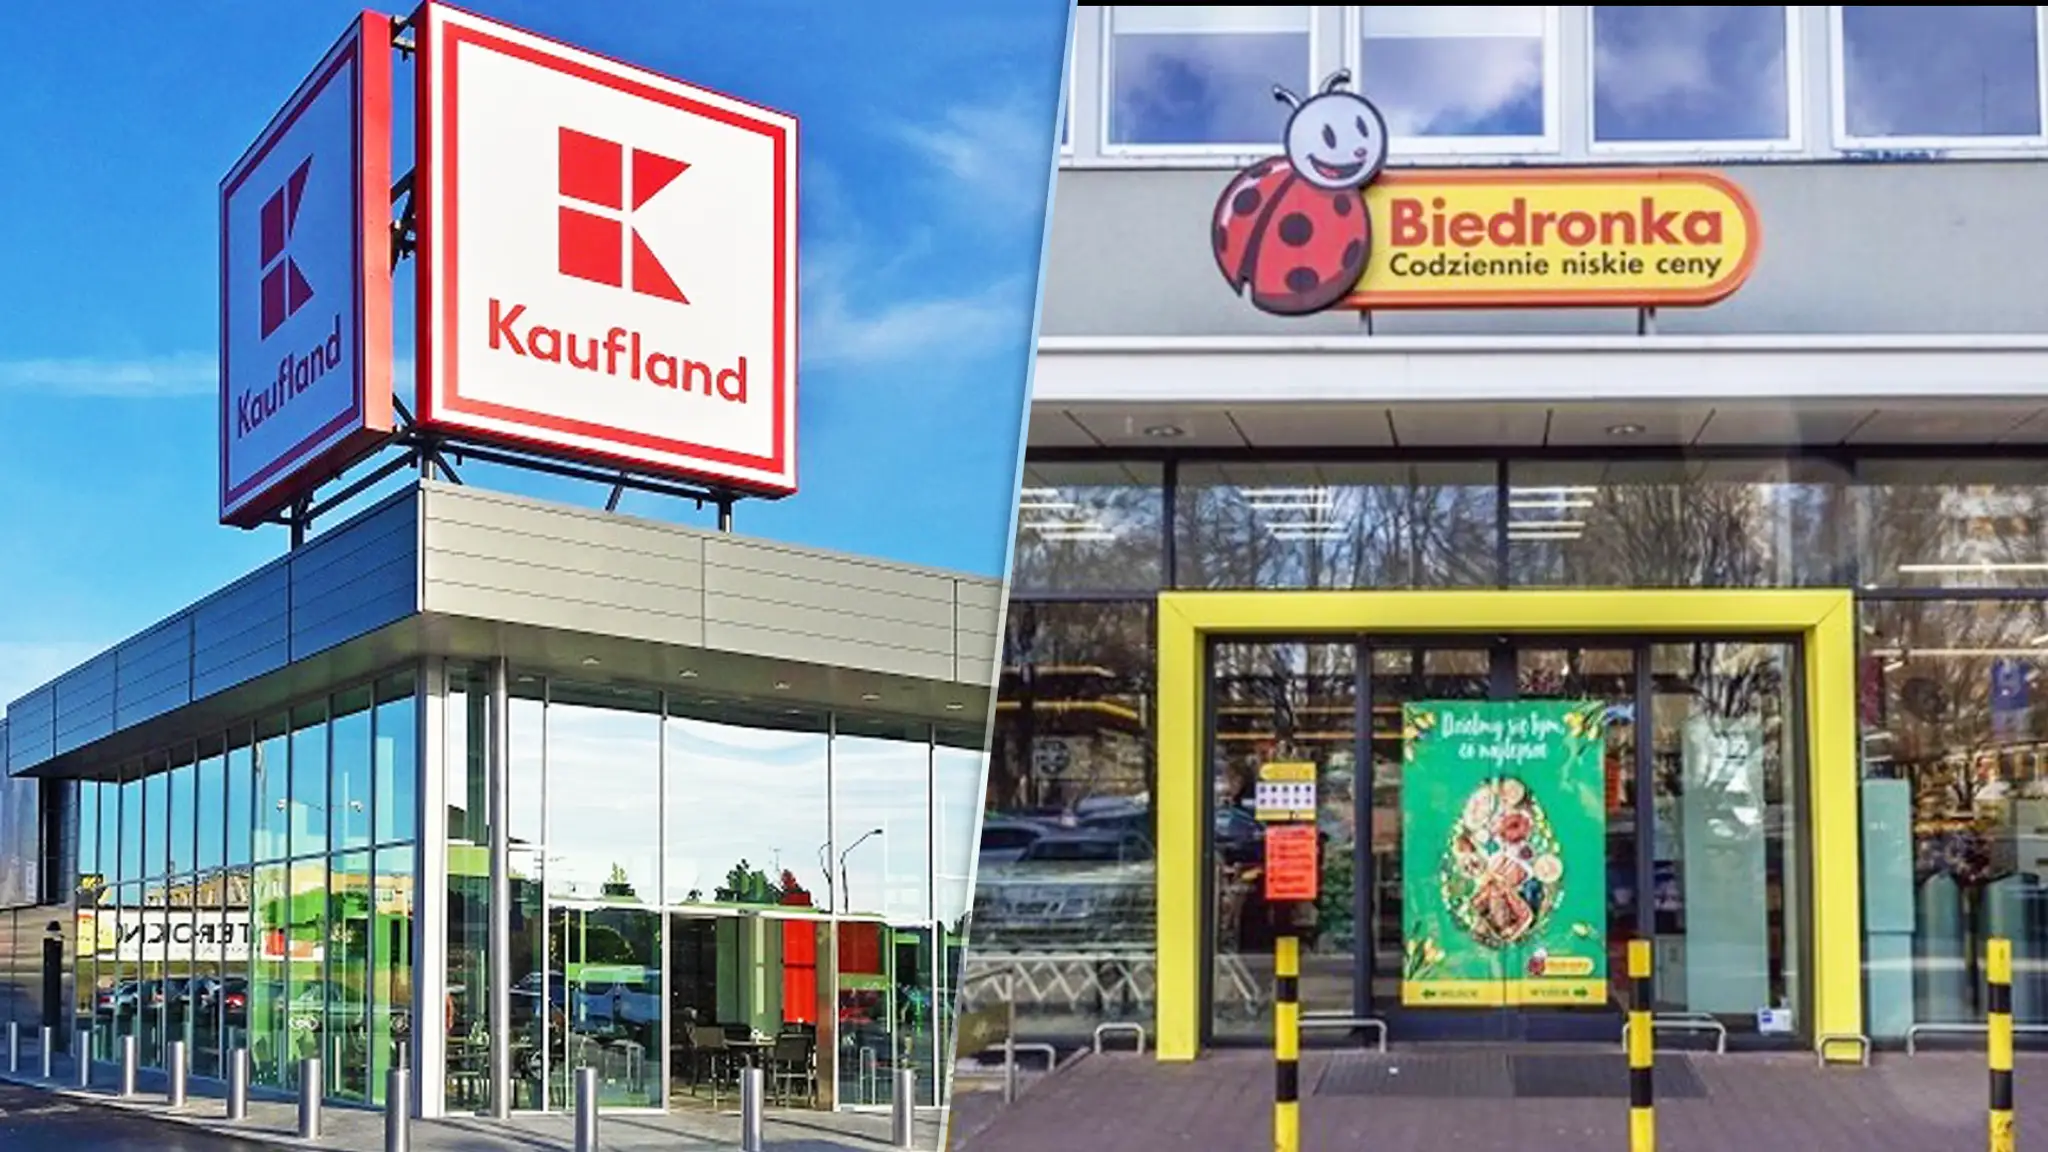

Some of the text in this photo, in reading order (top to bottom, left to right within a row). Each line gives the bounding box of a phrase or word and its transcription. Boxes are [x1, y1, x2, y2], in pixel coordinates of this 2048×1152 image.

[1389, 197, 1723, 247] Biedronka
[1389, 252, 1723, 278] Codziennie niskie ceny
[237, 311, 341, 439] Kaufland
[488, 297, 748, 404] Kaufland
